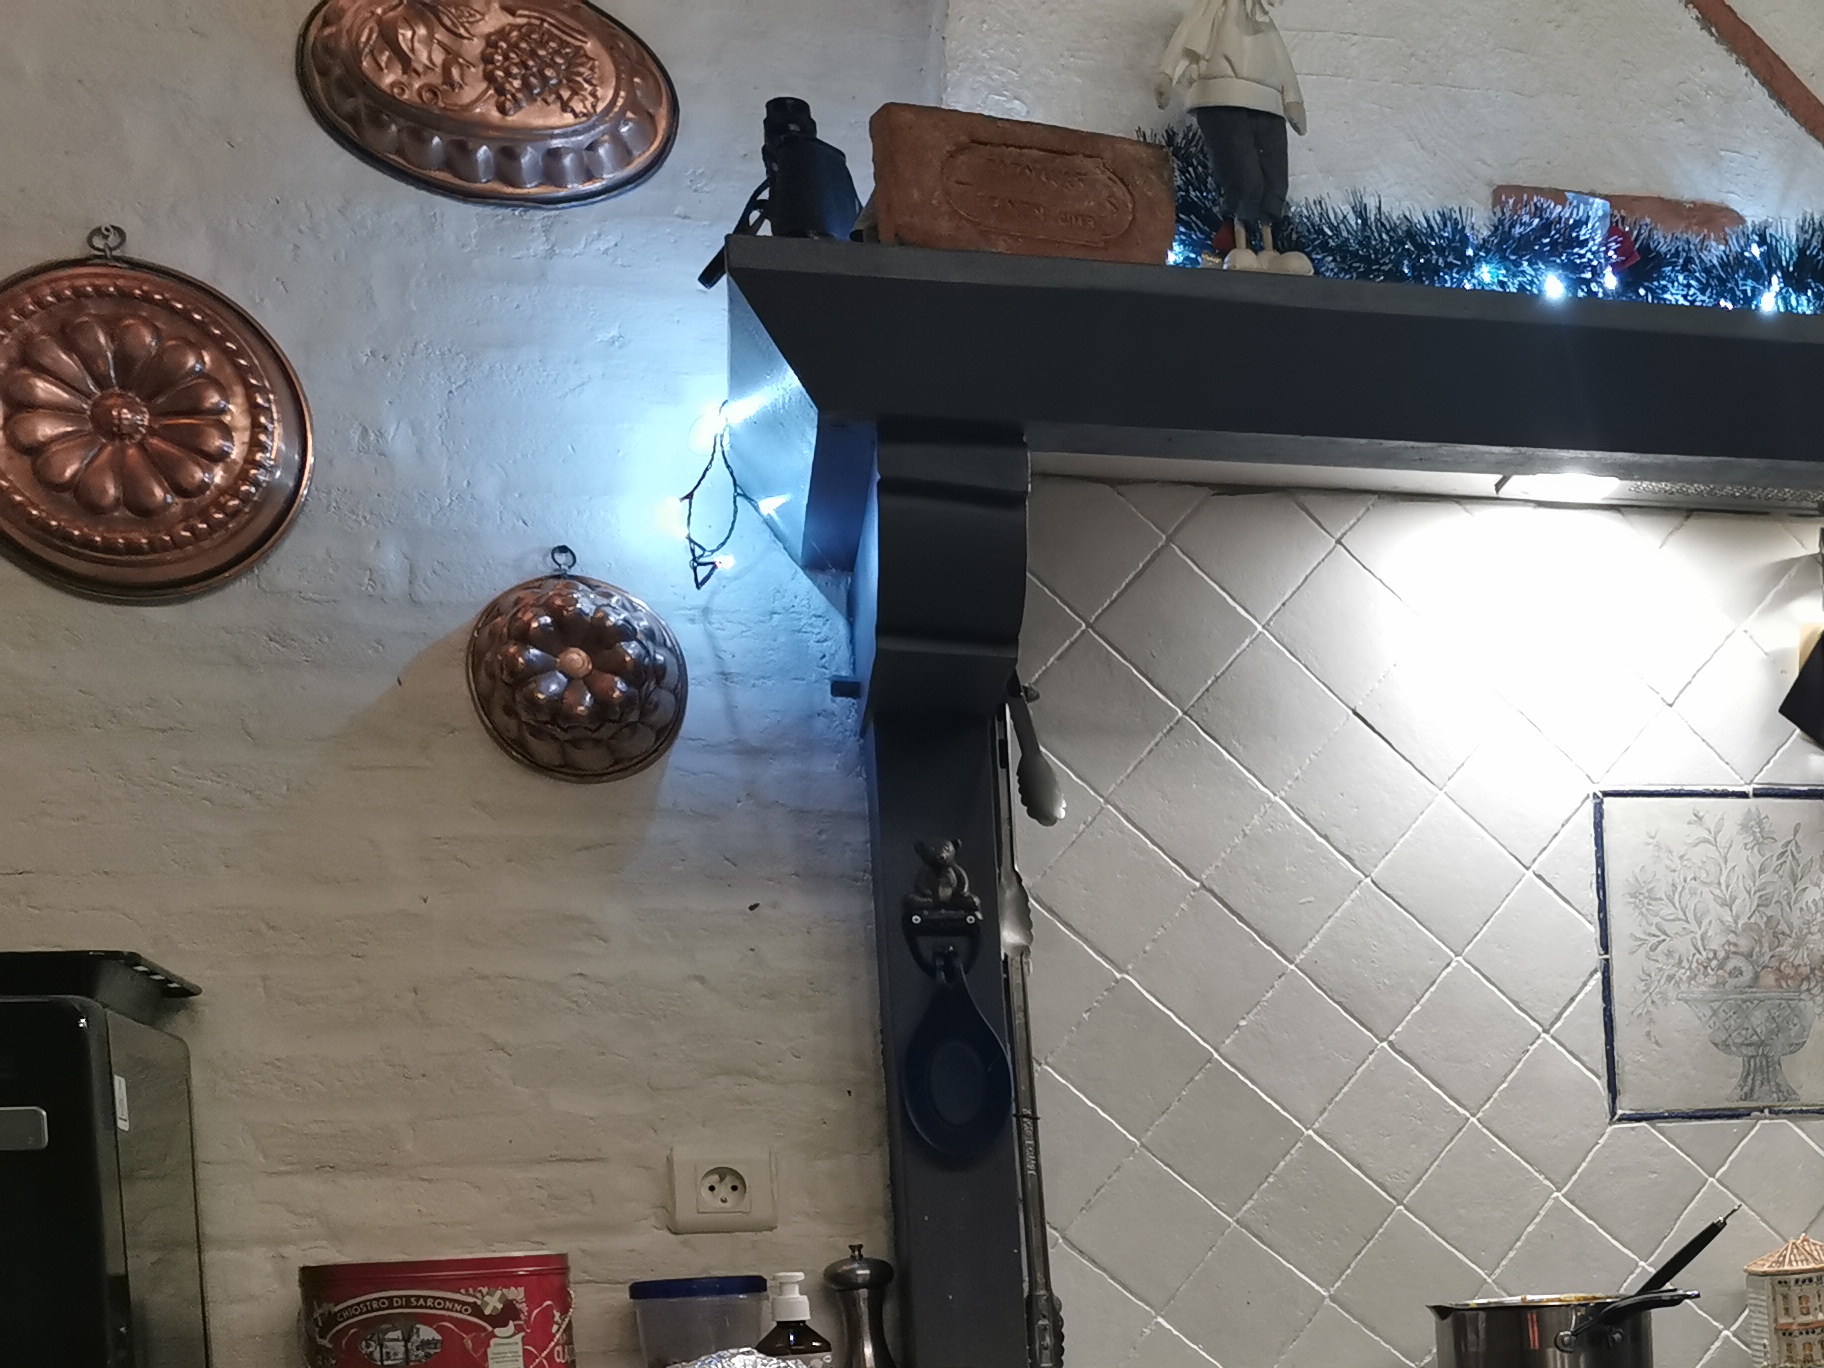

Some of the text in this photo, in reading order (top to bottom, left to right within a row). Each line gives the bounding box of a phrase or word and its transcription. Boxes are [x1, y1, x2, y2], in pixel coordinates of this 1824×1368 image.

[335, 1297, 472, 1322] CHIOSTRO DI SARONNO
